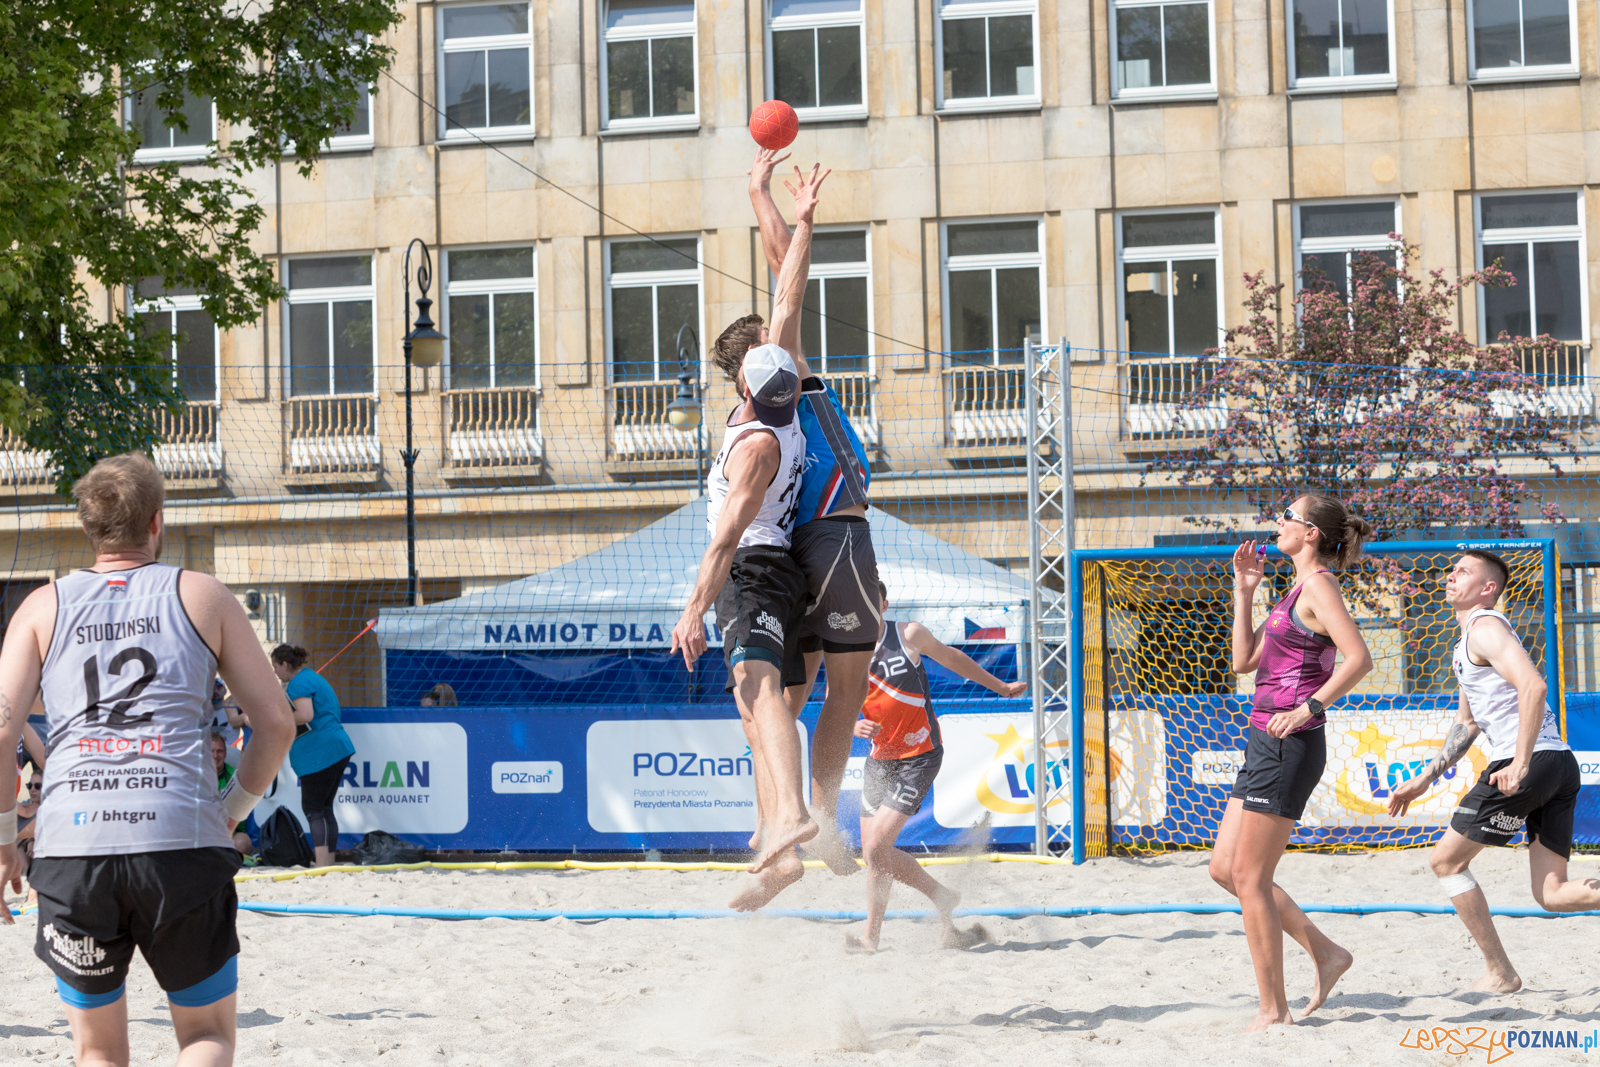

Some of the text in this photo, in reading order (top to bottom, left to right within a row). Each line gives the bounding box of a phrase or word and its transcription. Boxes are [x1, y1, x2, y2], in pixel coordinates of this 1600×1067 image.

[76, 615, 161, 645] STUDZIŃSKI
[484, 623, 598, 643] NAMIOT
[608, 623, 664, 642] DLA
[878, 655, 908, 678] 12
[83, 646, 158, 725] 12
[68, 767, 168, 778] BEACH HANDBALL
[340, 761, 430, 788] RLAN
[68, 777, 168, 792] TEAM GRU
[338, 795, 430, 805] GRUPA AQUANET
[633, 789, 709, 798] Patronat Honorowy
[892, 782, 919, 806] 12
[633, 799, 754, 809] Prezydenta Miasta Poznania
[102, 809, 156, 824] bhtgru
